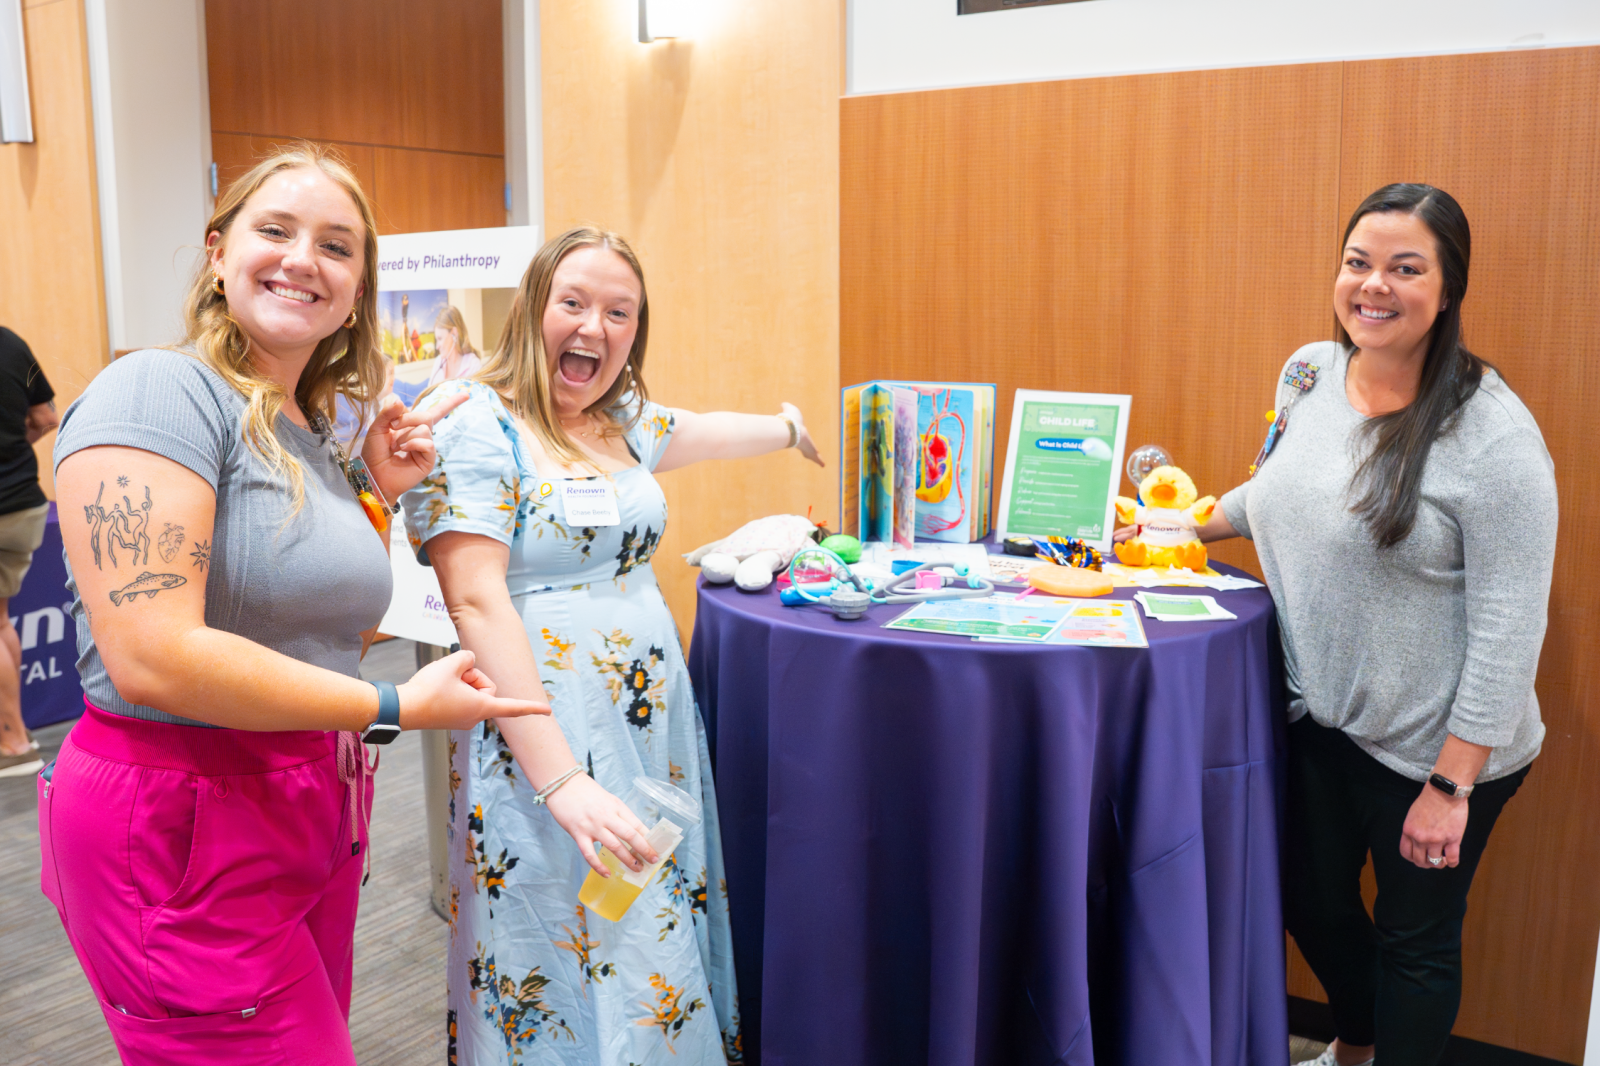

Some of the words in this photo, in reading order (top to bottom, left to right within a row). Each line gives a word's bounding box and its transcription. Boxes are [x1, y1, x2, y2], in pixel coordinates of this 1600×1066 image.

[407, 256, 420, 272] by
[423, 253, 501, 270] Philanthropy
[1039, 416, 1071, 426] CHILD
[1072, 418, 1096, 428] LIFE
[566, 486, 605, 494] Renown
